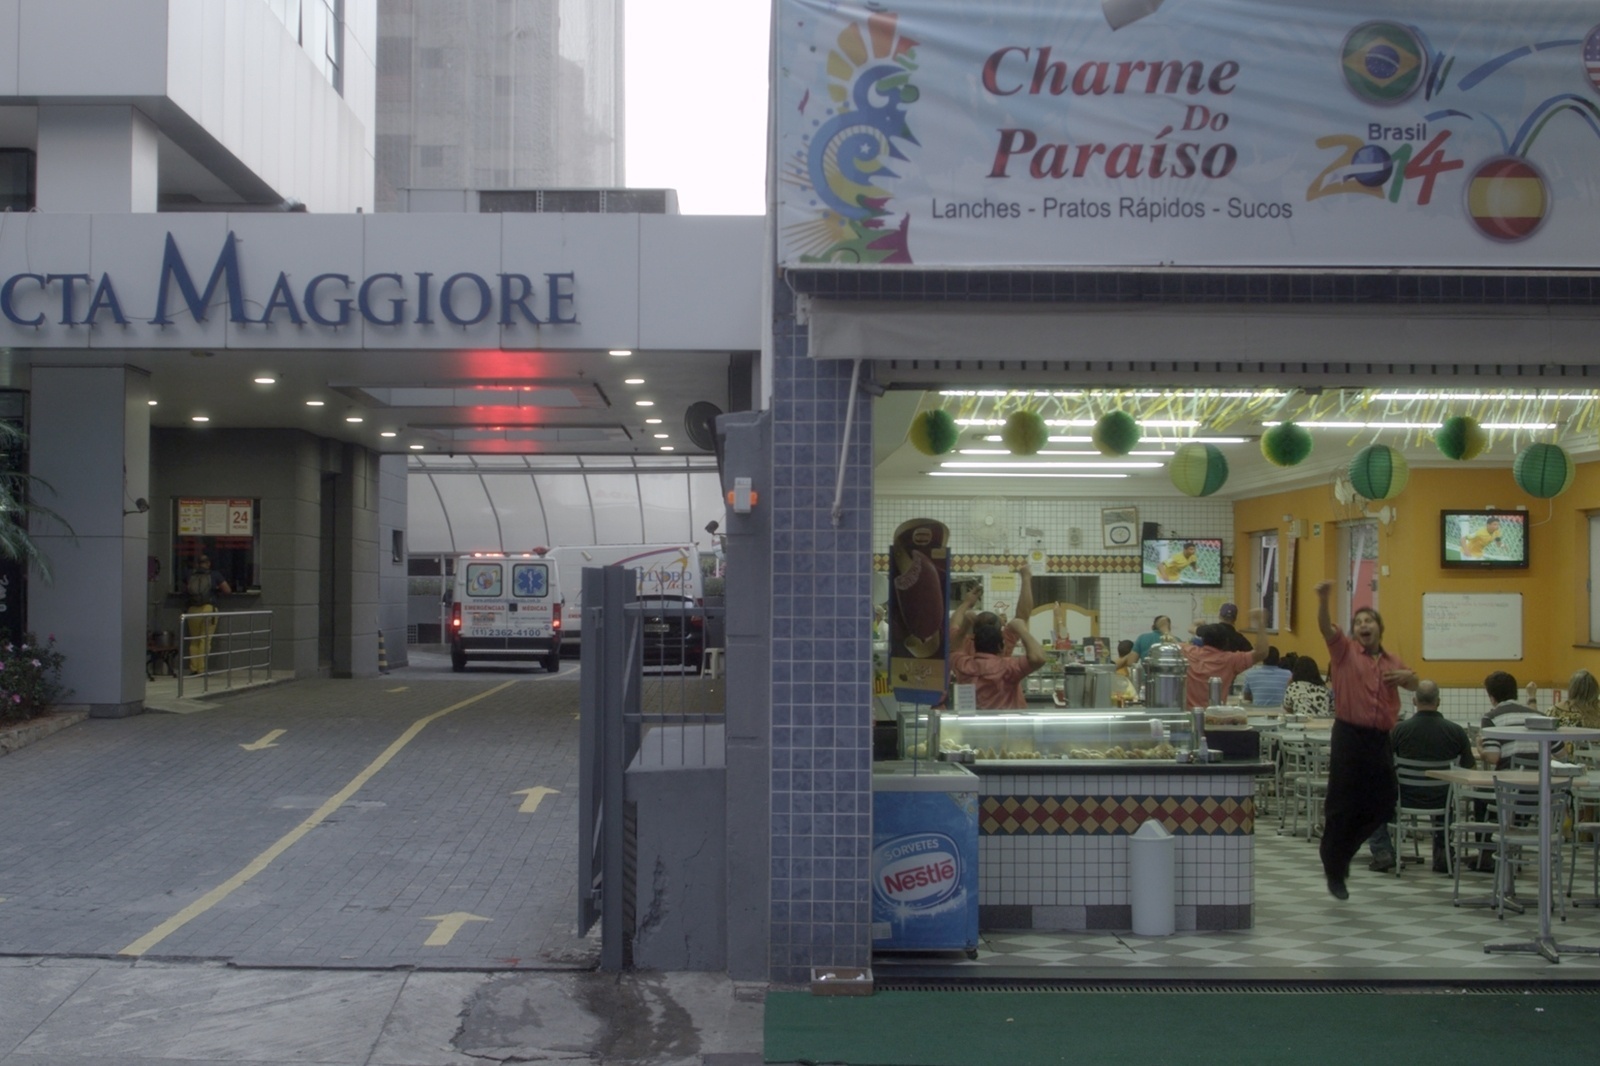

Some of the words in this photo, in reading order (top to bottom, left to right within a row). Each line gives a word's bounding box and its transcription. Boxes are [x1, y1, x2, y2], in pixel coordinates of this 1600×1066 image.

[983, 45, 1240, 97] Charme
[1182, 104, 1230, 132] Do
[1368, 123, 1428, 142] Brasil
[984, 124, 1238, 181] Paraíso
[1305, 128, 1464, 205] 2014
[932, 197, 1021, 218] Lanches
[1043, 197, 1111, 218] Pratos
[1119, 195, 1206, 223] Rápidos
[1227, 196, 1294, 219] Sucos
[148, 230, 578, 327] MAGGIORE
[232, 510, 249, 524] 24
[885, 838, 939, 860] SORVETES
